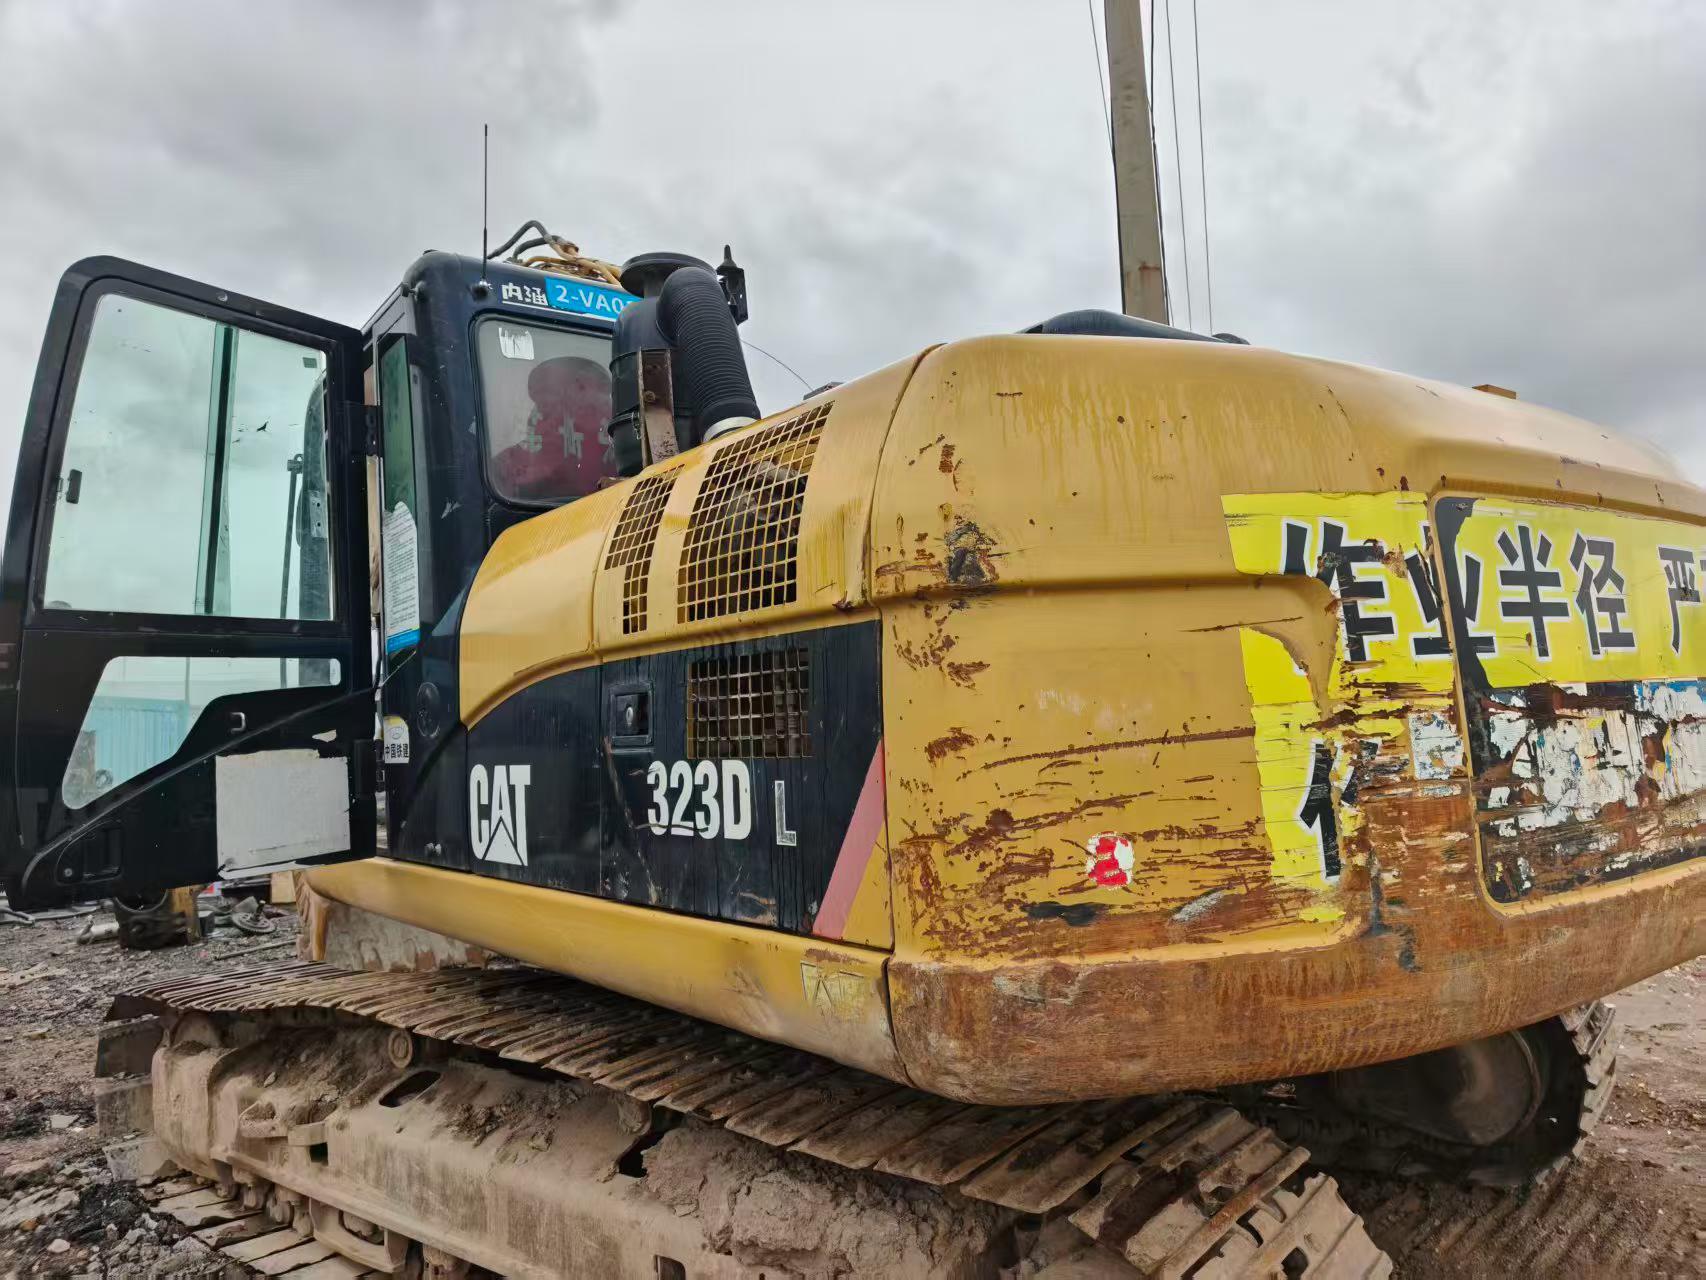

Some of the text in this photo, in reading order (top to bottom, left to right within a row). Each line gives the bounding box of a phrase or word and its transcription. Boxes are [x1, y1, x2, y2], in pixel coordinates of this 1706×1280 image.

[554, 284, 632, 314] 2-VA0
[1657, 545, 1706, 655] 严
[470, 763, 531, 866] CAT
[646, 760, 797, 846] 323D L
